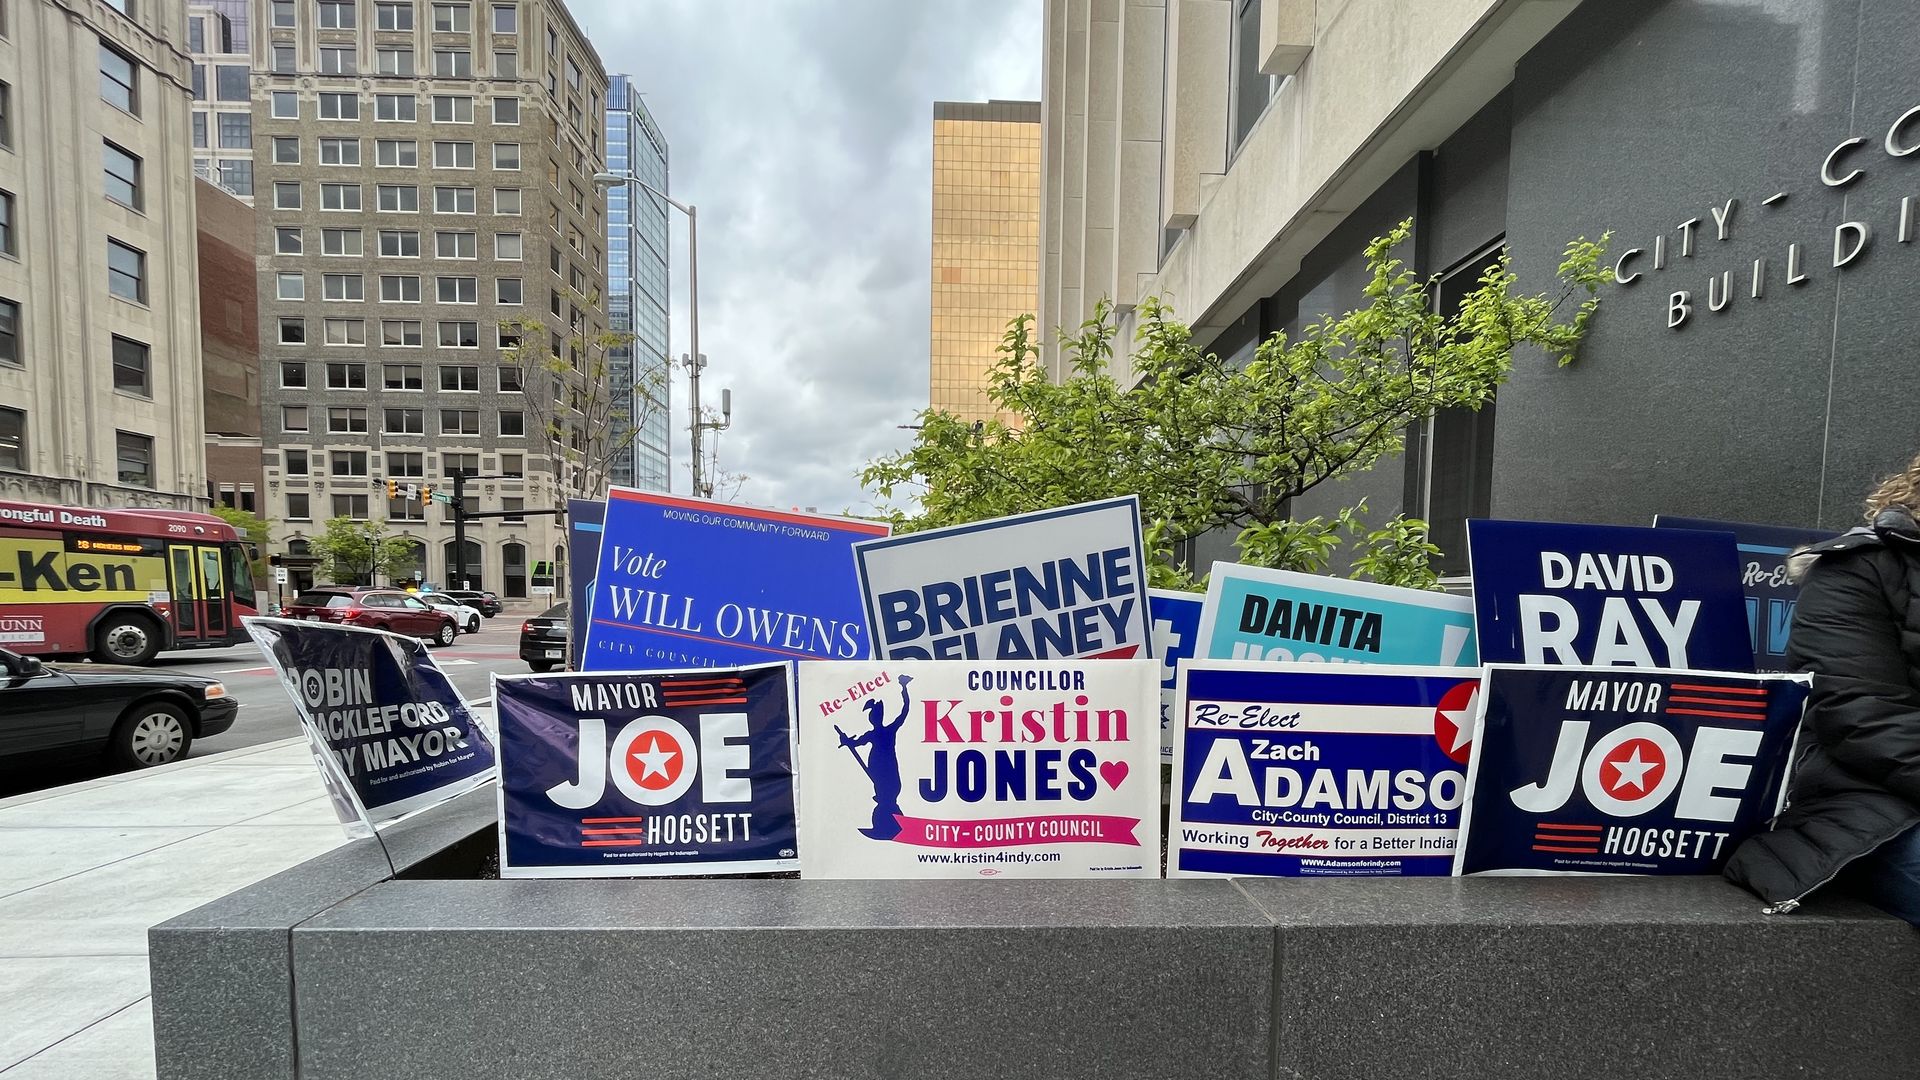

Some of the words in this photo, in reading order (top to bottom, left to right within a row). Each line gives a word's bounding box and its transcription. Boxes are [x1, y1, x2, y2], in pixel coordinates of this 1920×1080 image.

[0, 508, 54, 523] ongful
[60, 511, 107, 527] Death
[168, 523, 187, 533] 2090
[663, 509, 700, 523] MOVING
[701, 514, 721, 526] OUR
[722, 517, 780, 534] COMMUNITY
[781, 525, 830, 542] FORWARD
[613, 545, 667, 580] Vote
[1540, 551, 1675, 593] DAVID
[878, 546, 1135, 646] BRIENNE
[609, 584, 703, 634] WILL
[716, 602, 861, 660] OWENS
[1238, 593, 1384, 654] DANITA
[1518, 594, 1701, 669] RAY
[598, 640, 636, 655] CITY
[570, 682, 658, 711] MAYOR
[819, 671, 892, 717] Re-Elect
[968, 670, 1085, 691] COUNCILOR
[1564, 680, 1662, 713] MAYOR
[310, 700, 450, 743] ACKLEFORD
[920, 695, 1130, 744] Kristin
[1194, 703, 1300, 728] Re-Elect
[362, 726, 469, 773] MAYOR
[545, 712, 752, 810] JOE
[1250, 739, 1320, 761] Zach
[918, 749, 1098, 803] JONES
[1509, 720, 1764, 823] JOE
[647, 813, 752, 845] HOGSETT
[1039, 819, 1104, 838] COUNCIL
[1252, 809, 1331, 827] City-County
[1333, 812, 1384, 826] Council,
[1387, 812, 1431, 825] District
[1433, 812, 1447, 825] 13
[917, 851, 1061, 865] www.kristin4indy.com
[1182, 829, 1250, 849] Working
[1255, 830, 1330, 853] Together
[1334, 836, 1355, 850] for
[1359, 839, 1368, 850] a
[1373, 836, 1416, 850] Better
[1604, 825, 1730, 861] HOGSETT
